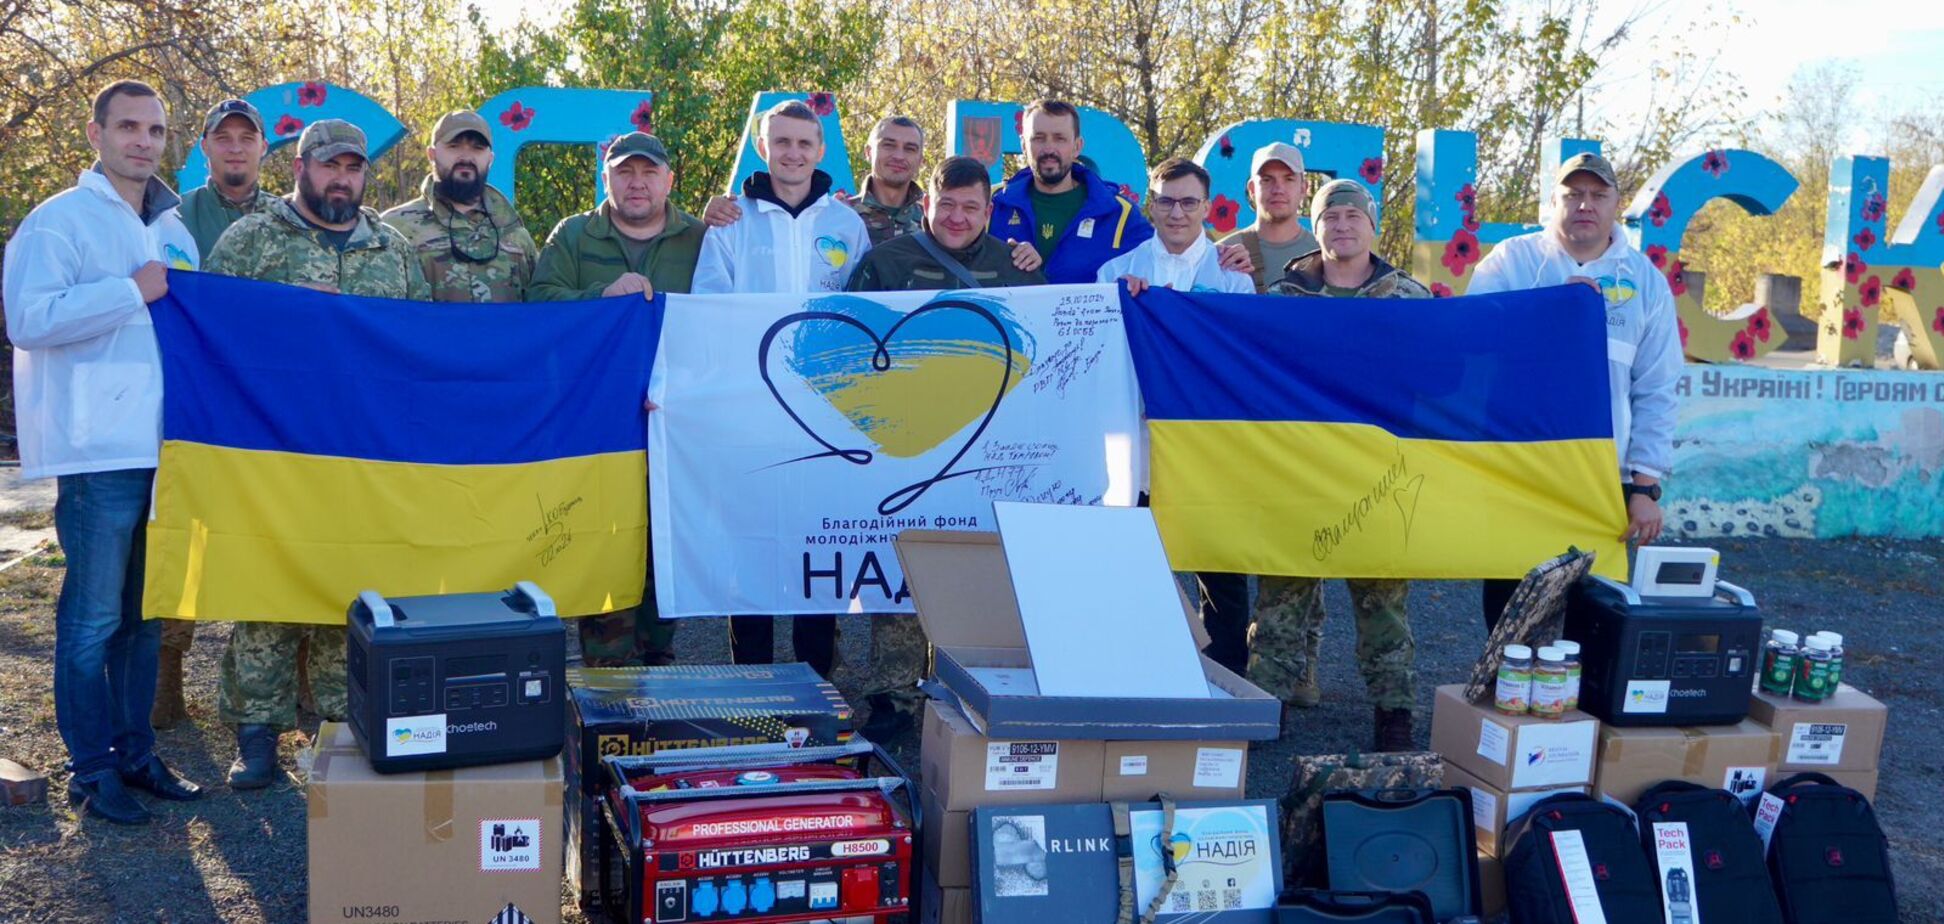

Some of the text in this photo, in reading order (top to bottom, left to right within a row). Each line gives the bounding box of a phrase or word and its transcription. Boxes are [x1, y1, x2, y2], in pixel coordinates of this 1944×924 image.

[822, 515, 978, 530] Благодійний фонд
[446, 720, 497, 734] choetech
[412, 729, 441, 740] НАДІЯ
[1762, 798, 1780, 813] Tech
[692, 815, 854, 836] PROFESSIONAL GENERATOR
[1658, 828, 1685, 838] Tech
[1044, 837, 1111, 853] RLINK
[1196, 839, 1257, 859] НАДІЯ
[1658, 839, 1687, 850] Pack
[492, 854, 530, 863] UN 3480
[698, 842, 879, 868] HÜTTENBERG H8500
[342, 905, 400, 919] UN3480
